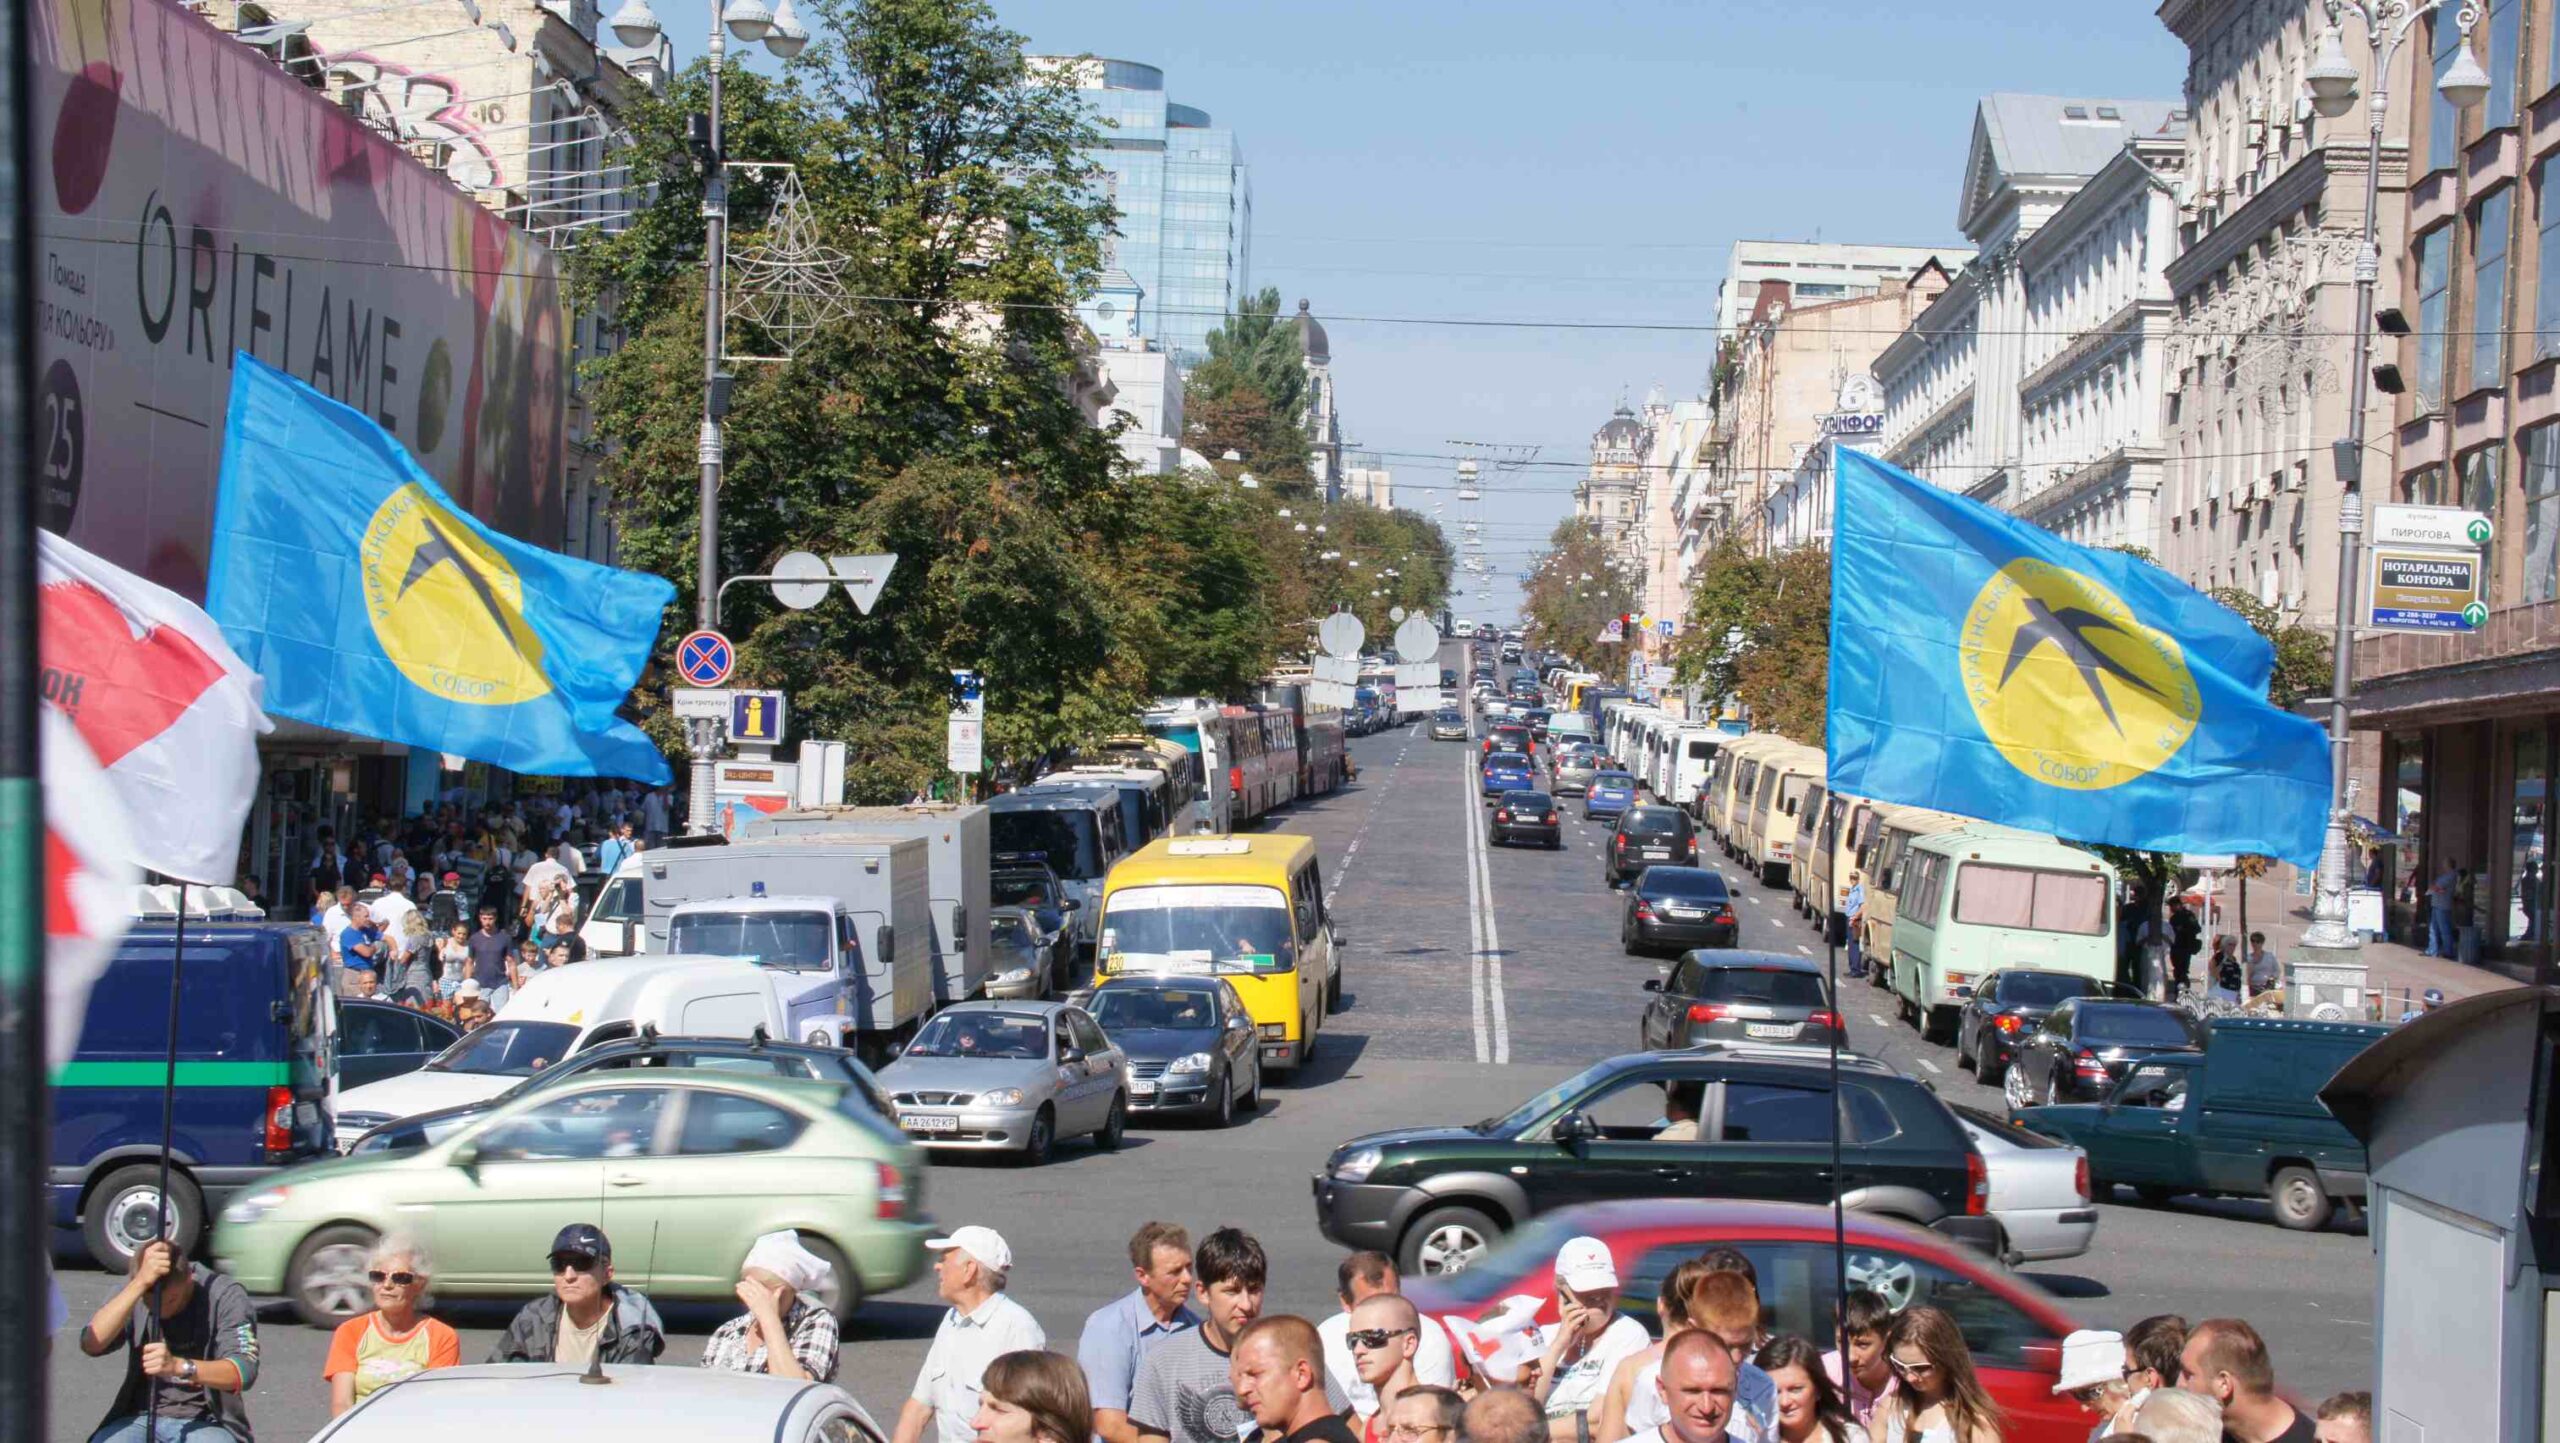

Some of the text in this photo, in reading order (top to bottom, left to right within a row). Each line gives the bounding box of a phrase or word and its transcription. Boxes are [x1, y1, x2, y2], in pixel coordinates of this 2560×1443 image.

[137, 188, 401, 433] ORIFLAME
[43, 392, 75, 481] 25
[2391, 528, 2452, 540] ПИРОГОВА
[2383, 562, 2469, 575] НОТАРІАЛЬНА
[2397, 575, 2454, 586] КОНТОРА
